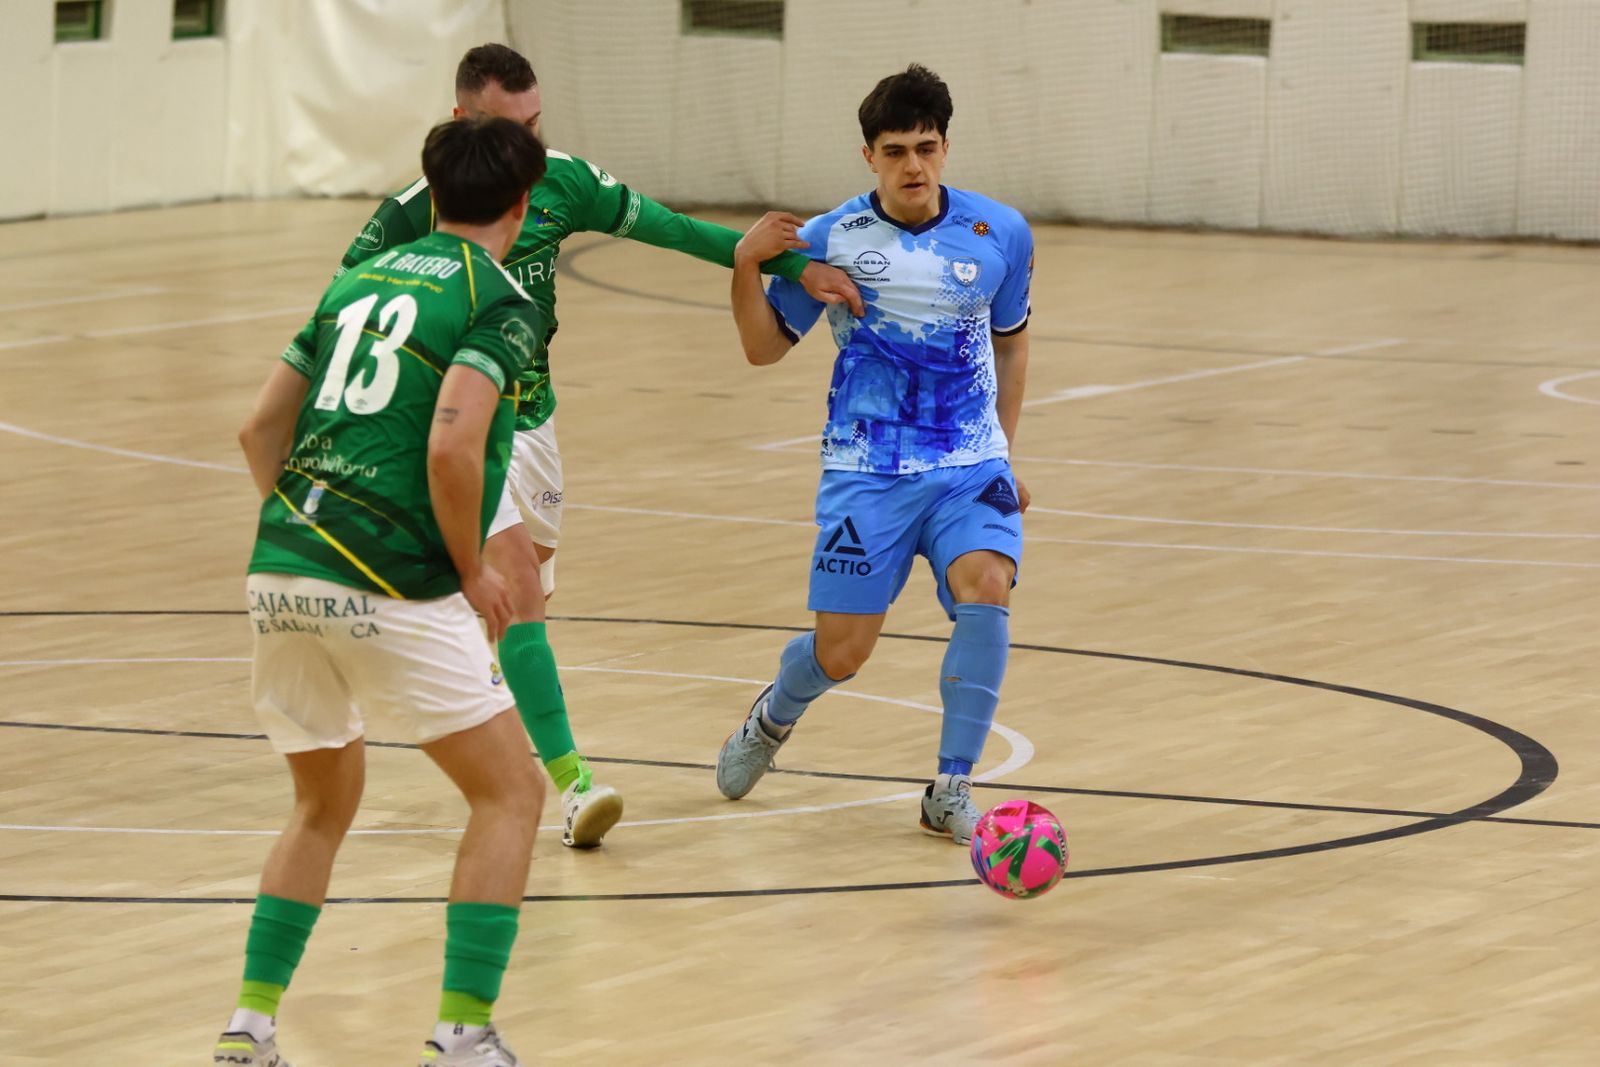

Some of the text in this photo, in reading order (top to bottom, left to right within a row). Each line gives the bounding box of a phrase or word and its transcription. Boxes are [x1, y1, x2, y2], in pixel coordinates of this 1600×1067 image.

[313, 293, 418, 415] 13
[815, 558, 872, 577] ACTIO
[294, 595, 377, 619] RURAL
